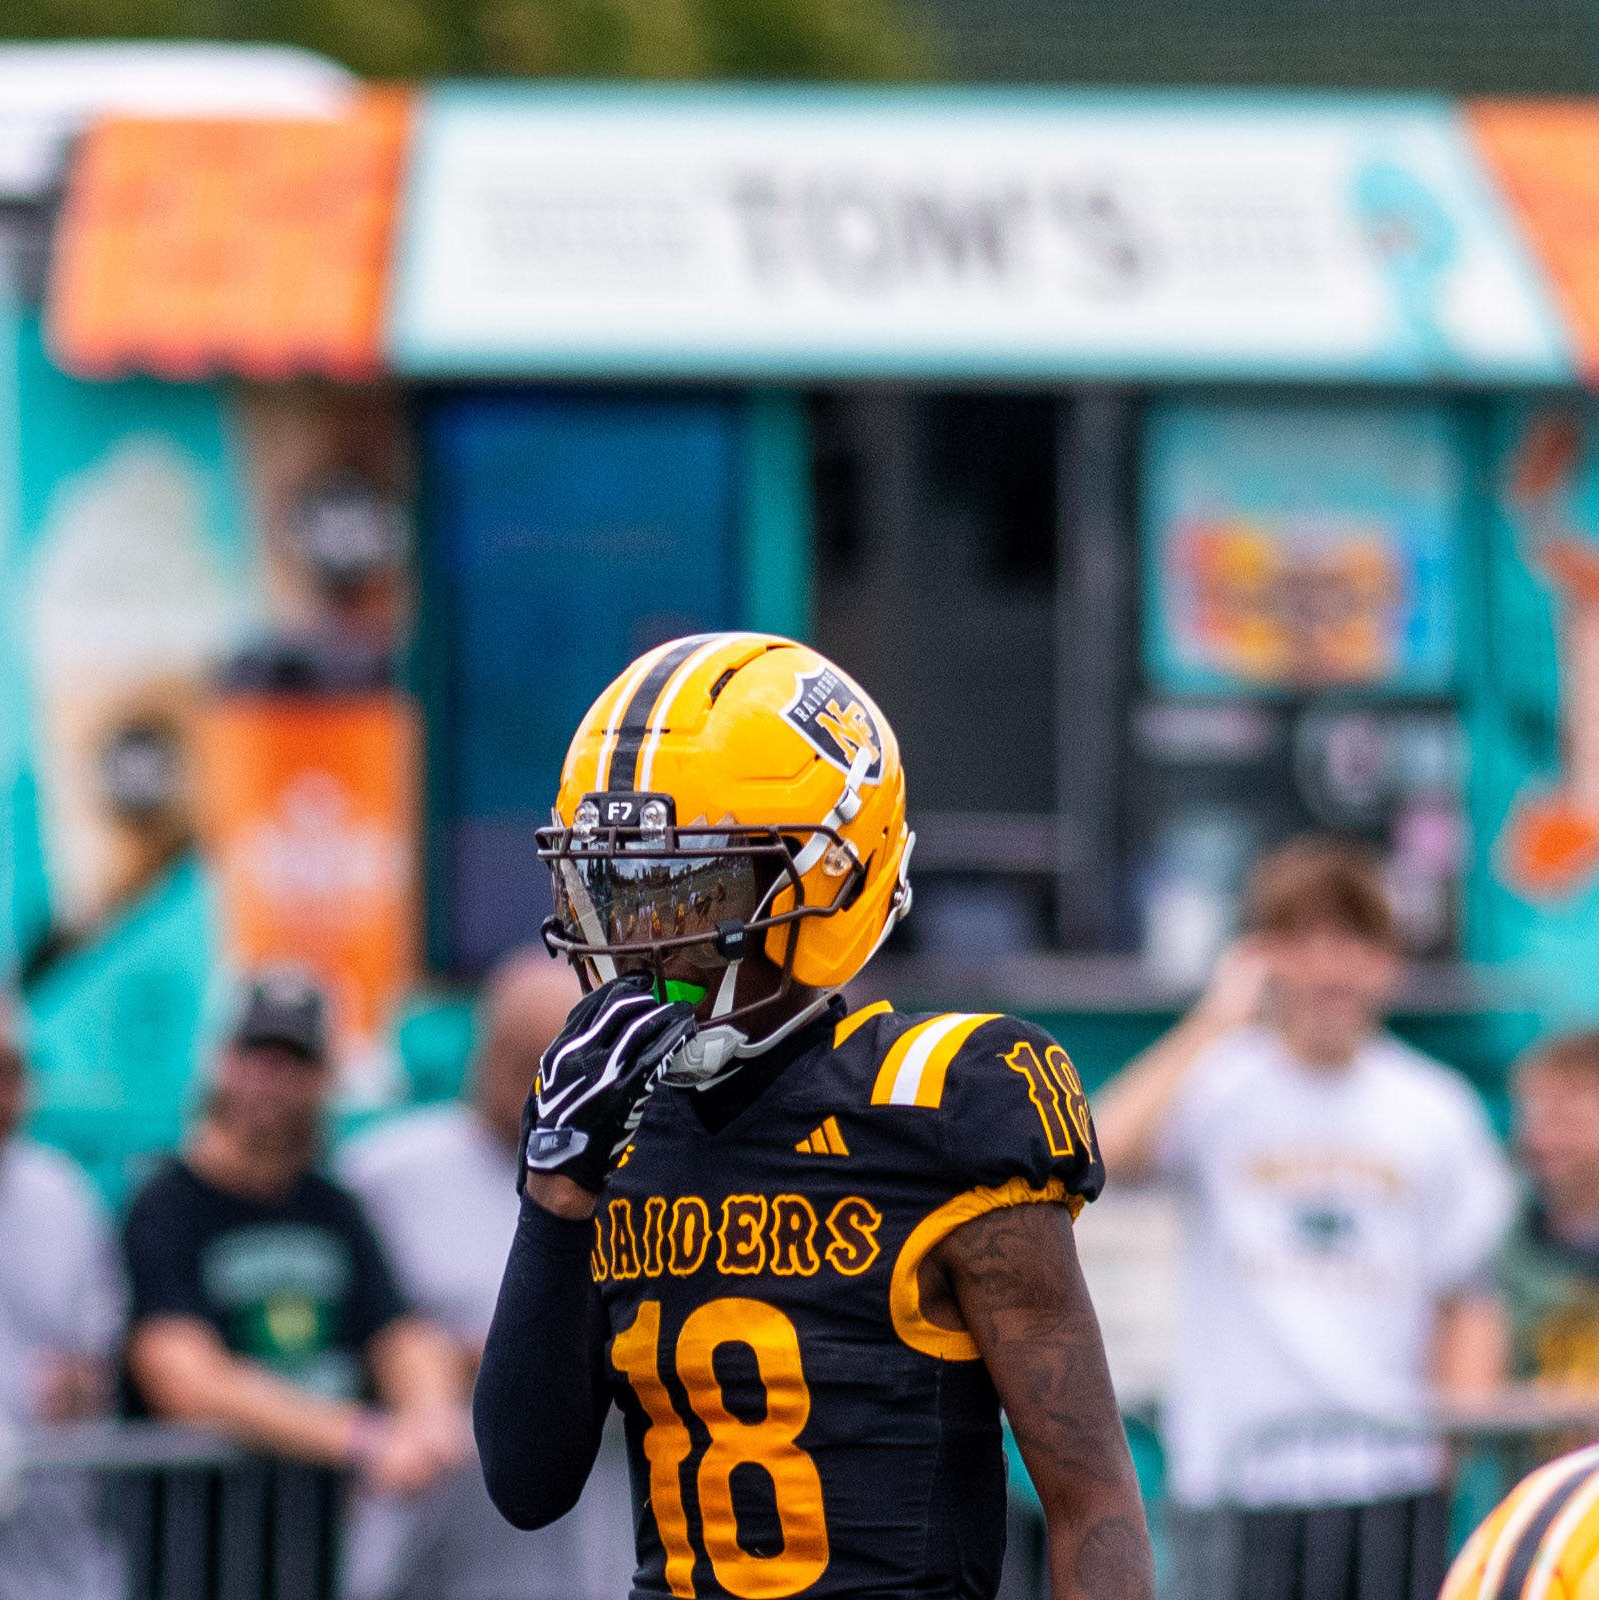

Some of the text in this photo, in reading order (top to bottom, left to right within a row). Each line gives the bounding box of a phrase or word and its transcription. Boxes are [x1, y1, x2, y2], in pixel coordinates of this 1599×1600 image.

[720, 162, 1170, 302] TOM'S
[607, 801, 633, 821] F7
[1004, 1040, 1094, 1165] 18
[610, 1296, 831, 1600] 18
